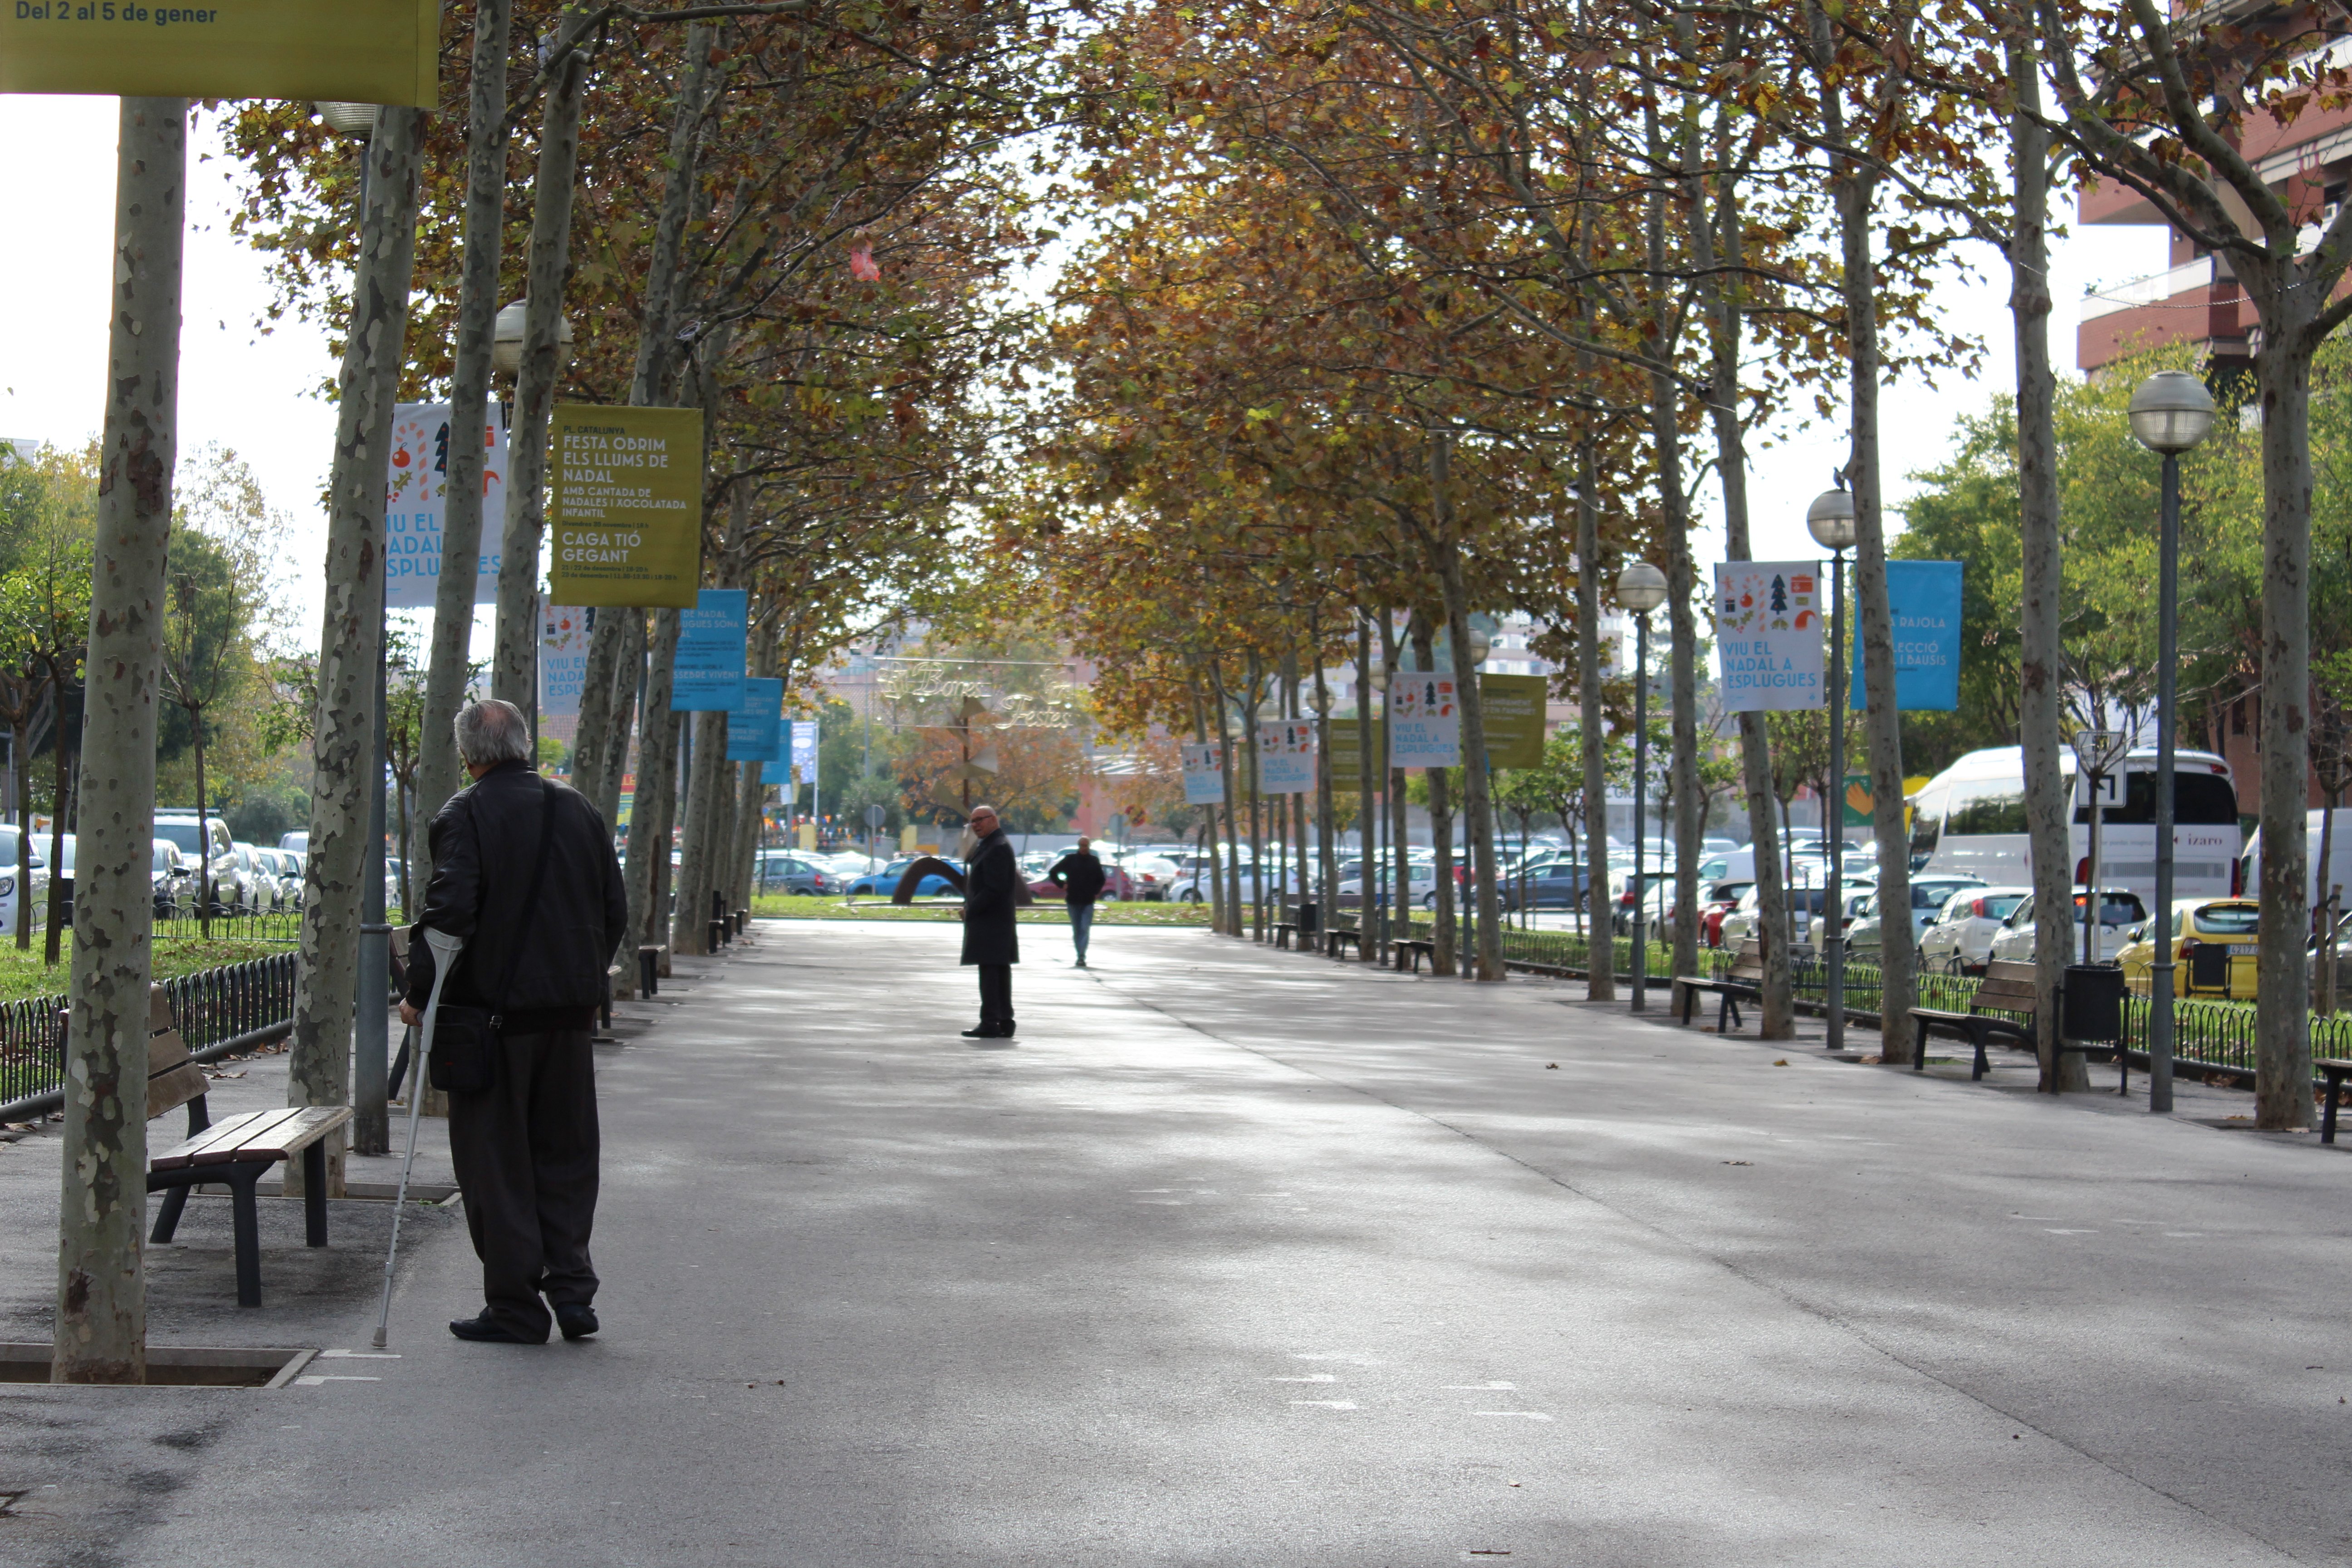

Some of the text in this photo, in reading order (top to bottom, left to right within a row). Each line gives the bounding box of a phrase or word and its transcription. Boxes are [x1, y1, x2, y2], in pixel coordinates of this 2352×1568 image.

[16, 0, 216, 26] Del 2 al 5 de gener
[564, 425, 625, 434] PL. CATALUNYA
[564, 436, 665, 451] FESTA OBRIM
[564, 452, 668, 468] ELS LLUMS DE
[563, 469, 614, 483] NADAL
[563, 486, 651, 497] AMB CANTADA DE
[563, 498, 686, 509] NADALES I XOCOLATADA
[563, 508, 605, 518] INFANTIL
[387, 514, 439, 532] IU EL
[388, 536, 442, 554] ADAL
[562, 530, 641, 547] CAGA TIÓ
[562, 549, 628, 563] GEGANT
[1900, 617, 1945, 627] RAJOLA
[1724, 641, 1772, 656] VIU EL
[547, 658, 568, 669] VIU
[1726, 657, 1793, 672] NADAL A
[1907, 655, 1946, 665] BAUSIS
[911, 662, 982, 698] Bones
[1728, 673, 1816, 689] ESPLUGUES
[995, 694, 1068, 730] Festes
[1394, 723, 1426, 732] VIU EL
[1396, 734, 1439, 742] NADAL A
[1396, 744, 1455, 753] ESPLUGUES
[2188, 833, 2222, 845] izaro
